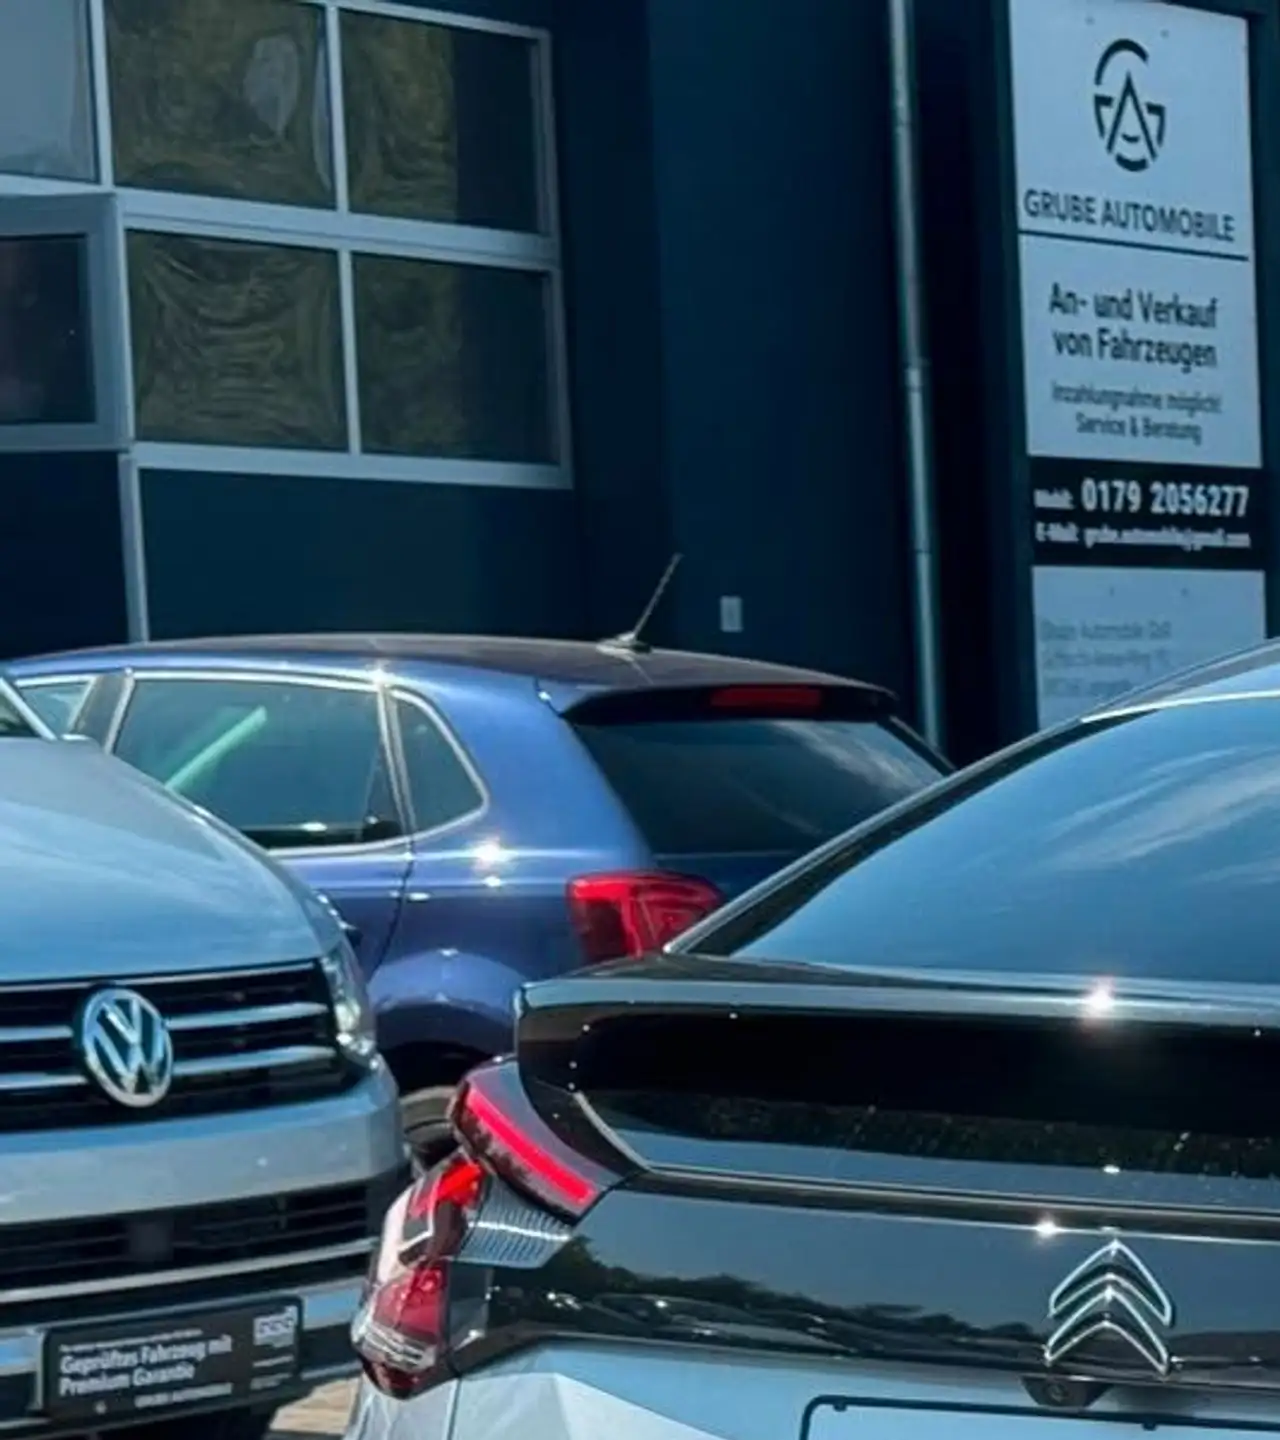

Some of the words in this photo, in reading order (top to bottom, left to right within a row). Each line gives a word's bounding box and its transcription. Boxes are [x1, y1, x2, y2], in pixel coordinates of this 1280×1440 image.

[1023, 187, 1098, 226] GRUBE
[1100, 199, 1236, 243] AUTOMOBILE
[1049, 281, 1088, 316] An-
[1093, 287, 1134, 322] und
[1136, 289, 1218, 329] Verkauf
[1053, 330, 1093, 358] von
[1096, 326, 1218, 375] Fahrzeugen
[1080, 477, 1143, 514] 0179
[1149, 481, 1250, 518] 2056277
